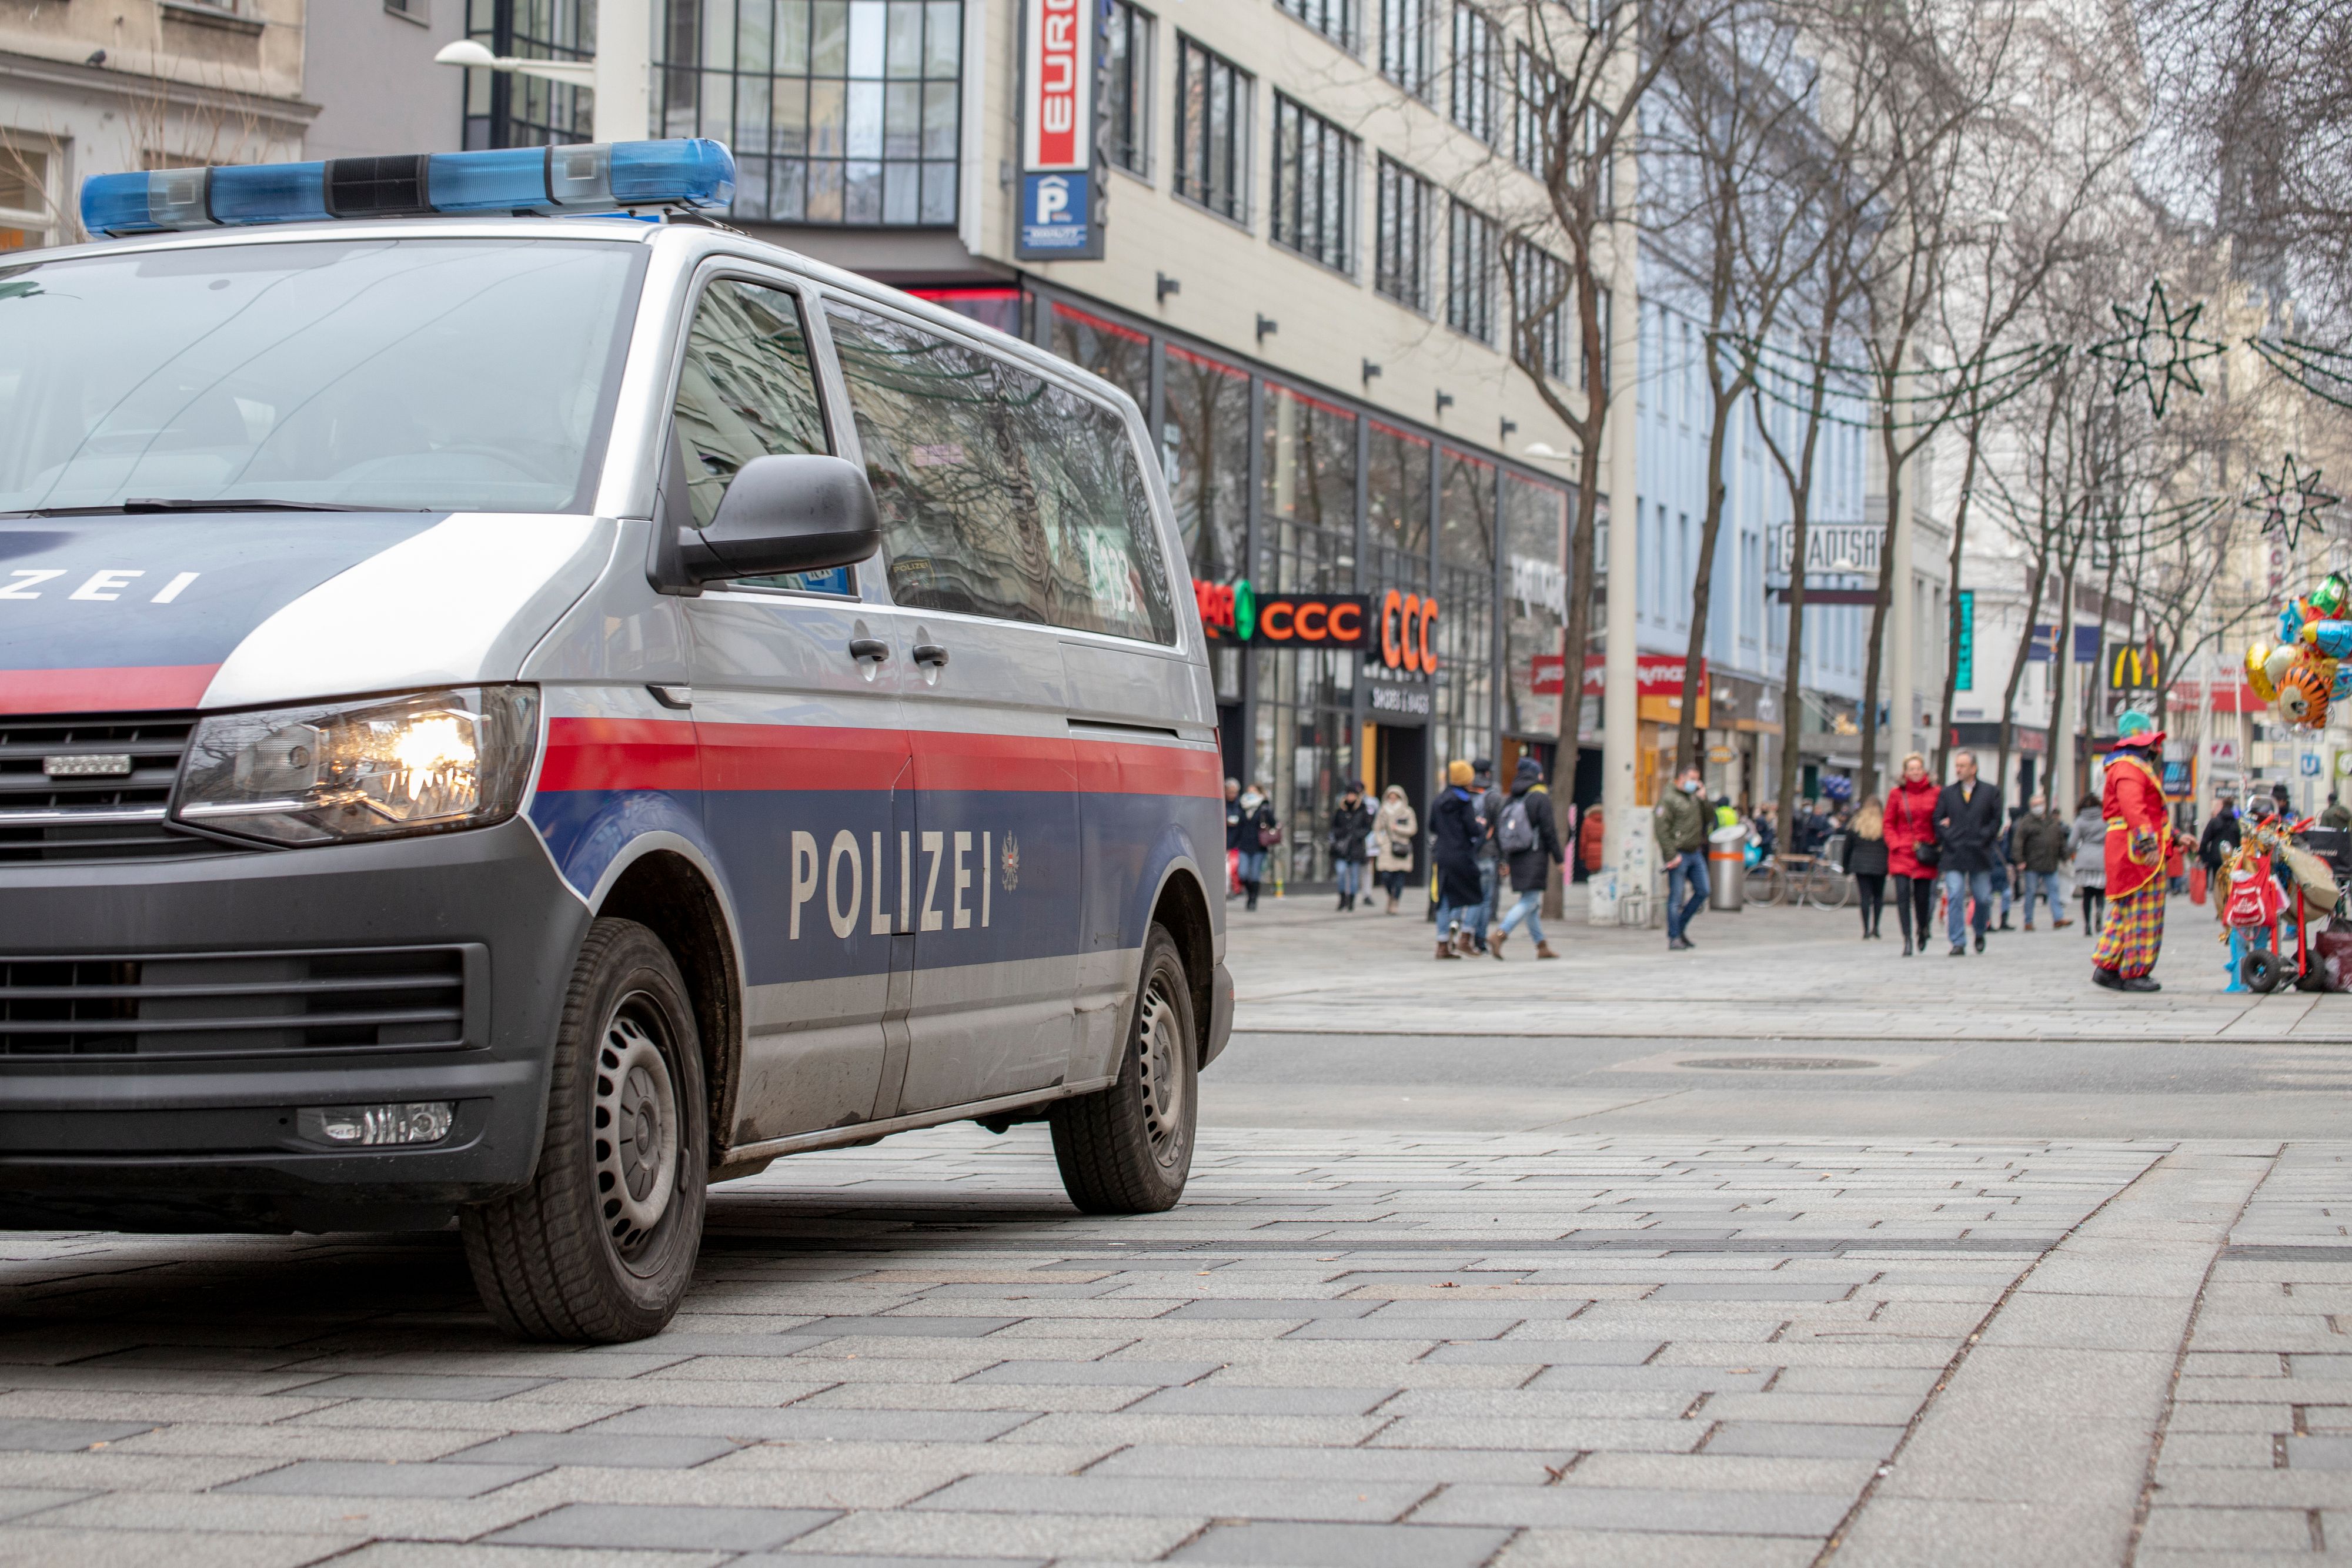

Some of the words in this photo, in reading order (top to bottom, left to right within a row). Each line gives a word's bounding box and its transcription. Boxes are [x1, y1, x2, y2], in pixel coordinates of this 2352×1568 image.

[893, 560, 929, 573] POLIZEI
[1100, 546, 1136, 613] 133
[1260, 601, 1362, 641] CCC
[1381, 589, 1439, 676] CCC
[2302, 757, 2316, 774] U
[790, 829, 991, 940] POLIZEI
